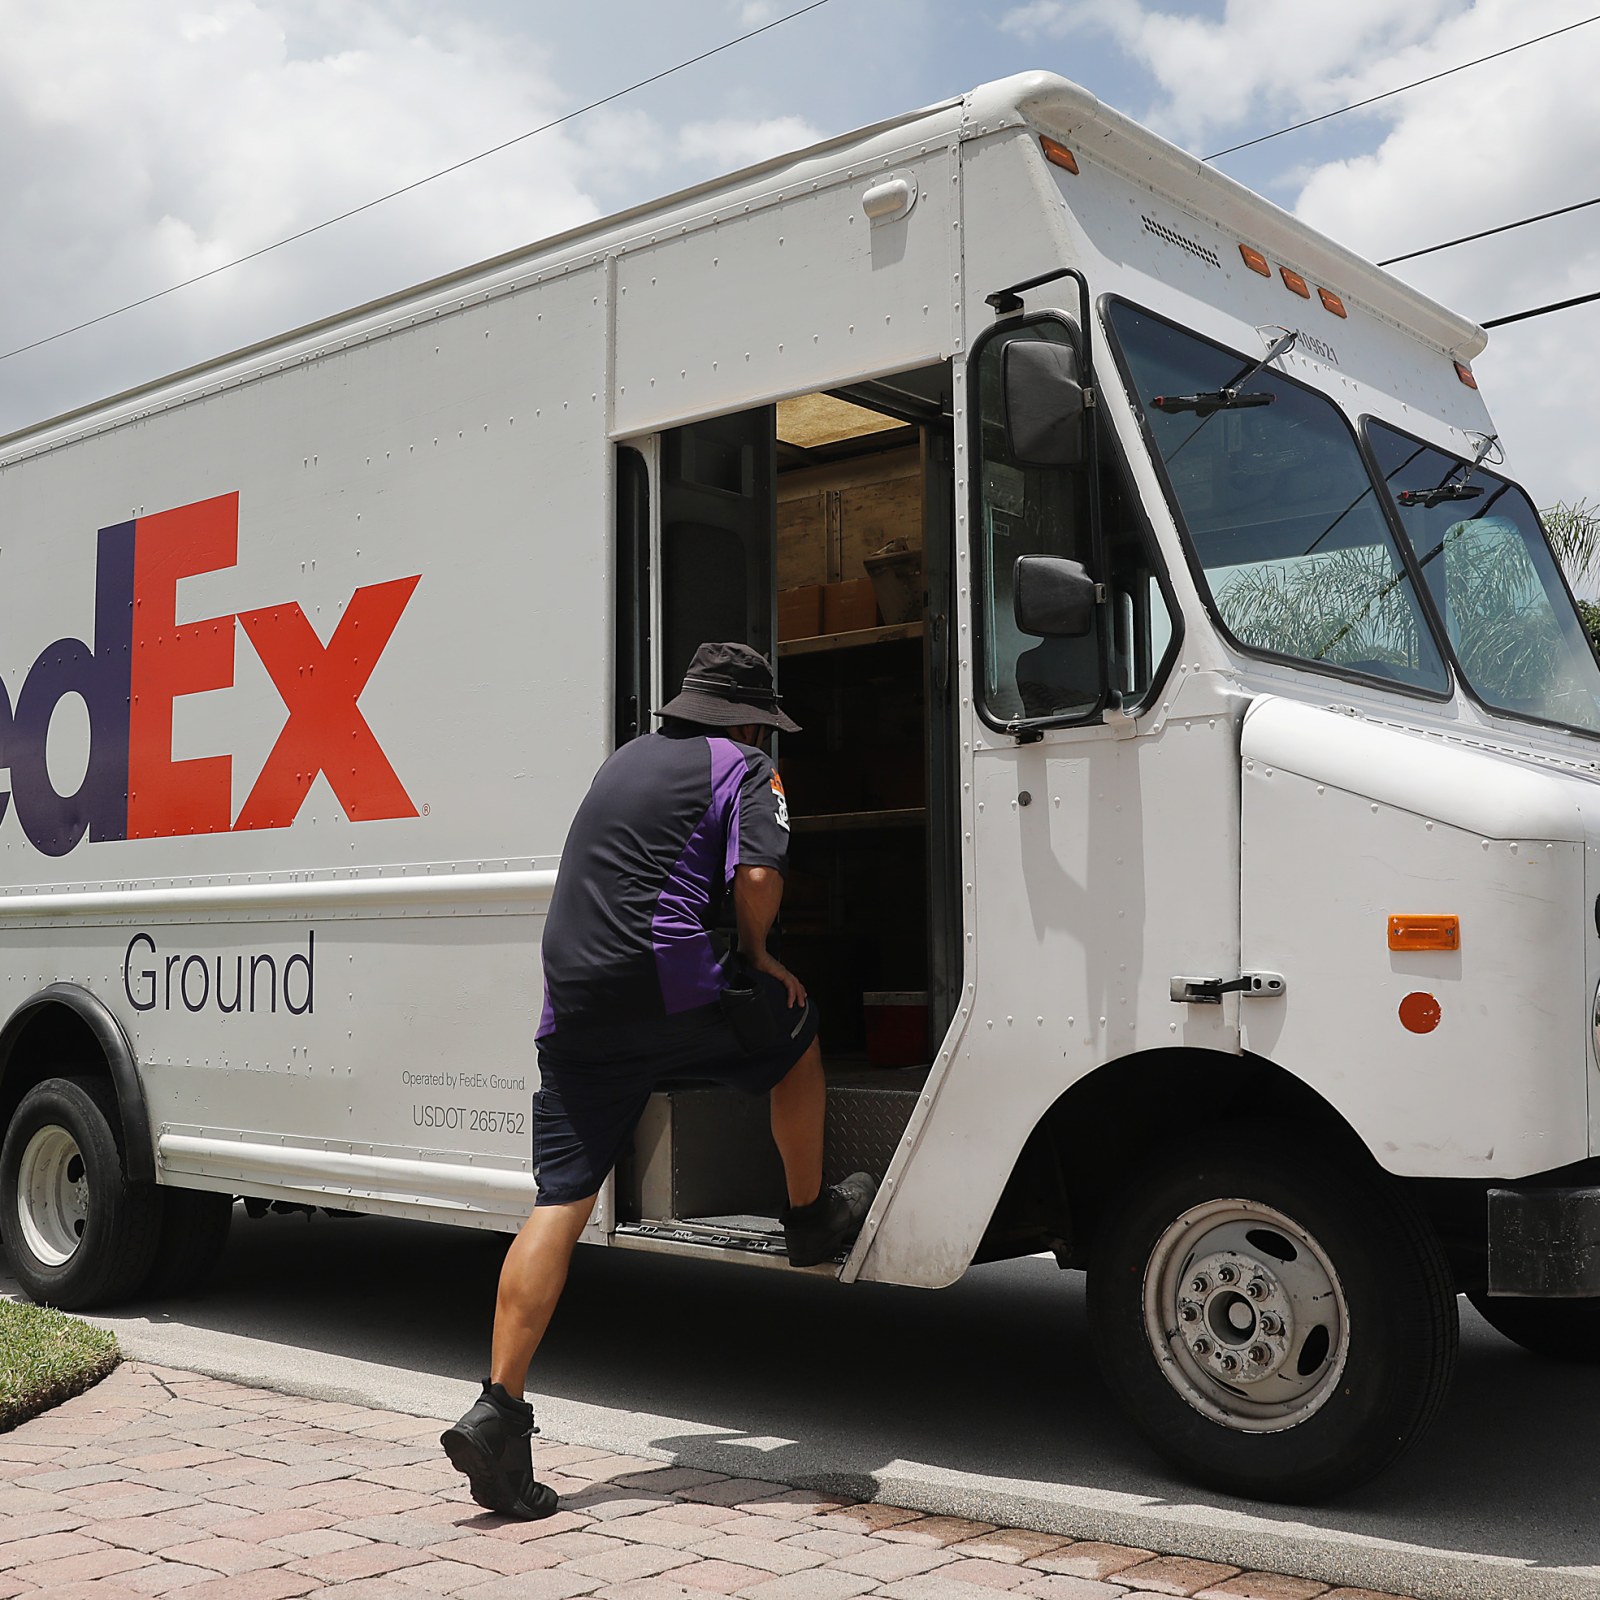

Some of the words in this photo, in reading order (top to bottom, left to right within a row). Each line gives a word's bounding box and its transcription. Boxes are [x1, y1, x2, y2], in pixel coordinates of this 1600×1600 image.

[0, 490, 423, 857] dEx
[124, 929, 315, 1015] Ground
[402, 1070, 444, 1087] Operated
[446, 1072, 457, 1089] by
[459, 1073, 488, 1088] FedEx
[490, 1075, 525, 1090] Ground
[413, 1104, 466, 1130] USDOT
[469, 1110, 525, 1134] 265752
